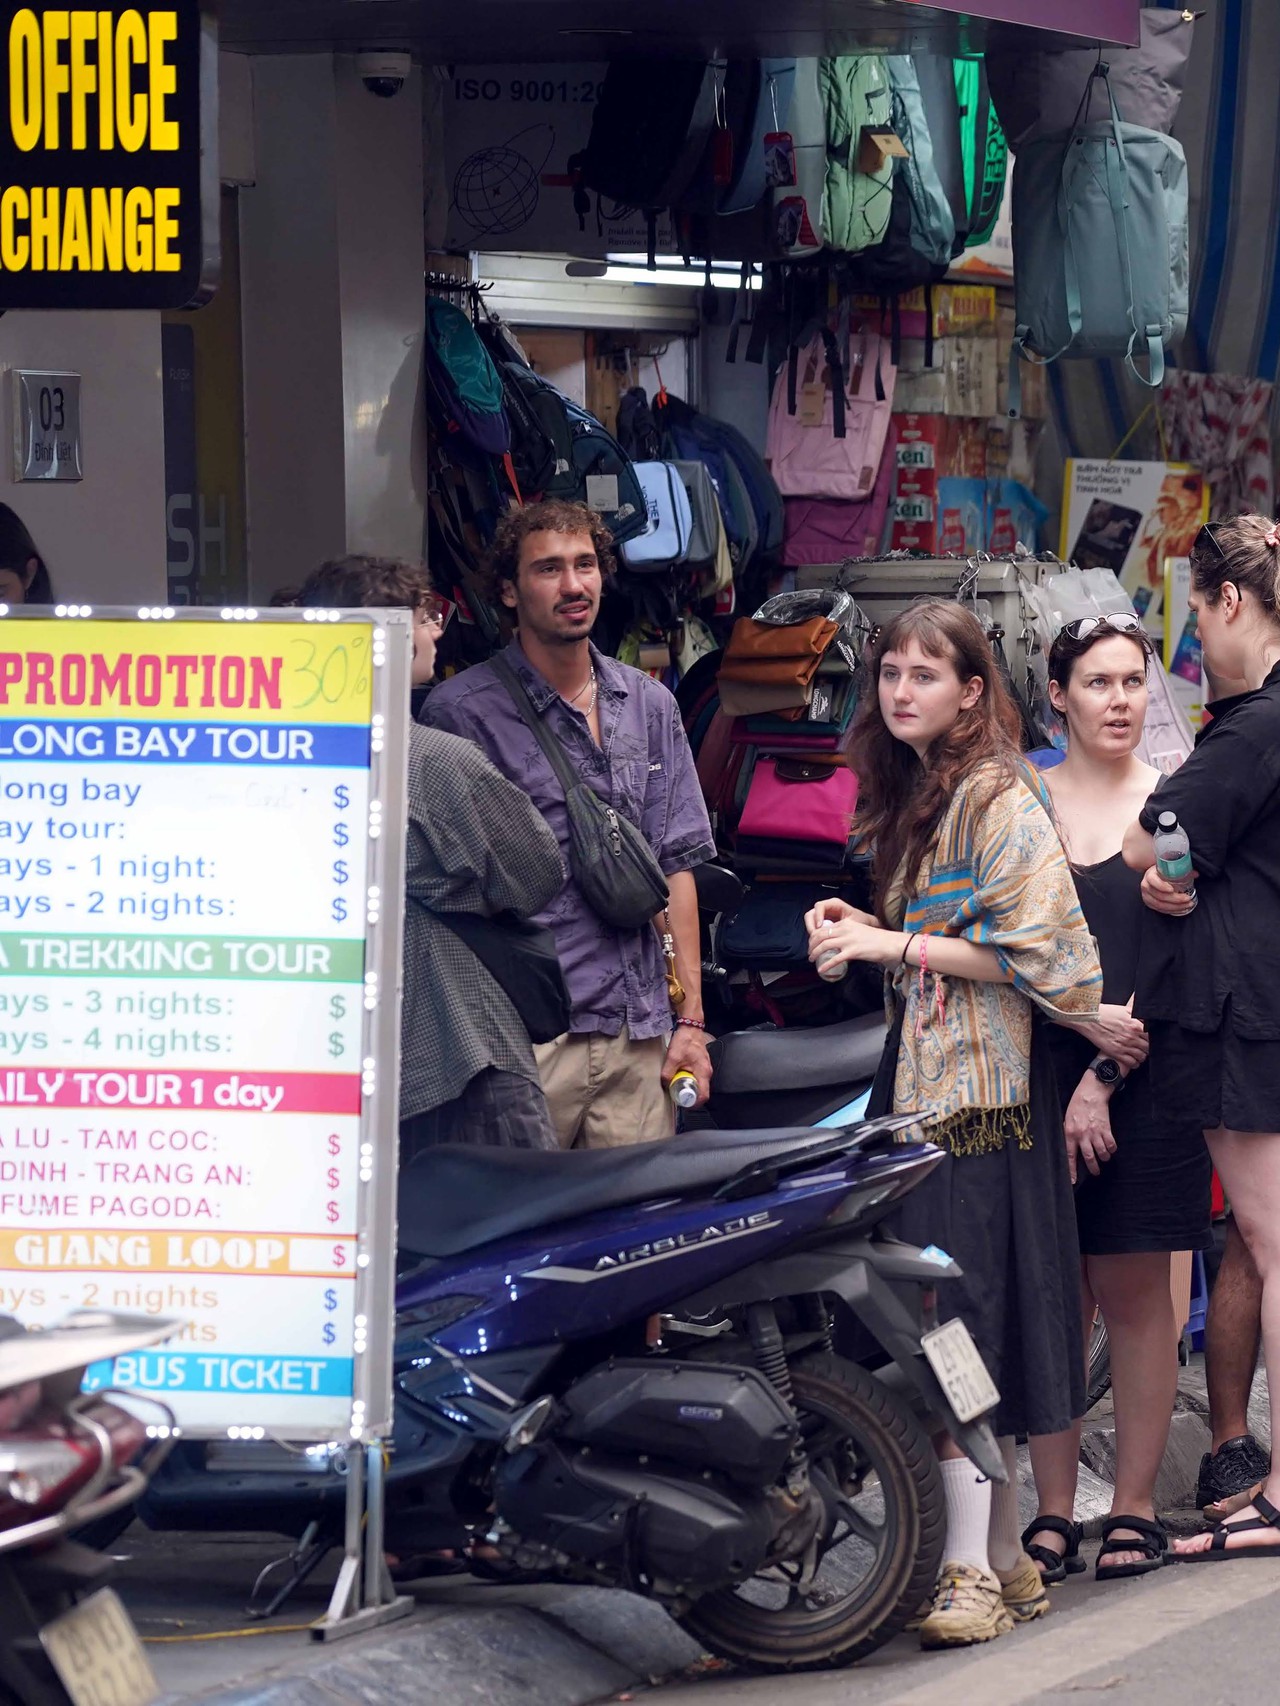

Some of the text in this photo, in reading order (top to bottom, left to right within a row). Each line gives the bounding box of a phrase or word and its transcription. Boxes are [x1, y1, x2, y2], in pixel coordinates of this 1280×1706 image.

[9, 8, 180, 153] OFFICE
[455, 79, 501, 101] ISO
[0, 185, 181, 273] CHANGE
[39, 386, 65, 432] 03
[649, 498, 660, 519] THE
[0, 652, 283, 710] PROMOTION
[290, 637, 372, 710] 30%
[811, 688, 820, 719] LONGCHAMP
[115, 727, 197, 759] BAY
[205, 728, 314, 760] TOUR
[0, 776, 68, 807] ong
[82, 777, 142, 808] bay
[333, 784, 350, 811] $
[46, 817, 125, 840] tour:
[333, 822, 349, 848] $
[90, 854, 102, 877] 1
[119, 855, 216, 884] night:
[333, 859, 349, 885] $
[88, 891, 104, 914] 2
[118, 893, 235, 919] nights:
[331, 897, 348, 923] $
[20, 939, 212, 973] TREKKING
[223, 942, 331, 974] TOUR
[85, 990, 102, 1013] 3
[115, 991, 234, 1021] nights:
[329, 994, 346, 1020] $
[83, 1026, 102, 1051] 4
[115, 1028, 234, 1058] nights:
[328, 1032, 345, 1057] $
[0, 1071, 285, 1113] ILY TOUR 1 day
[15, 1127, 50, 1149] LU
[78, 1129, 138, 1151] TAM
[148, 1130, 218, 1152] COC:
[327, 1134, 341, 1156] $
[1, 1160, 67, 1182] DINH
[94, 1162, 194, 1185] TRANG
[204, 1164, 252, 1186] AN:
[326, 1167, 341, 1190] $
[90, 1195, 221, 1219] PAGODA:
[325, 1200, 340, 1224] $
[14, 1234, 346, 1270] GIANG LOOP $
[0, 1287, 45, 1313] ys
[82, 1283, 99, 1306] 2
[113, 1283, 219, 1314] nights
[323, 1288, 338, 1312] $
[322, 1321, 336, 1346] $
[113, 1356, 187, 1387] BUS
[196, 1357, 327, 1391] TICKET
